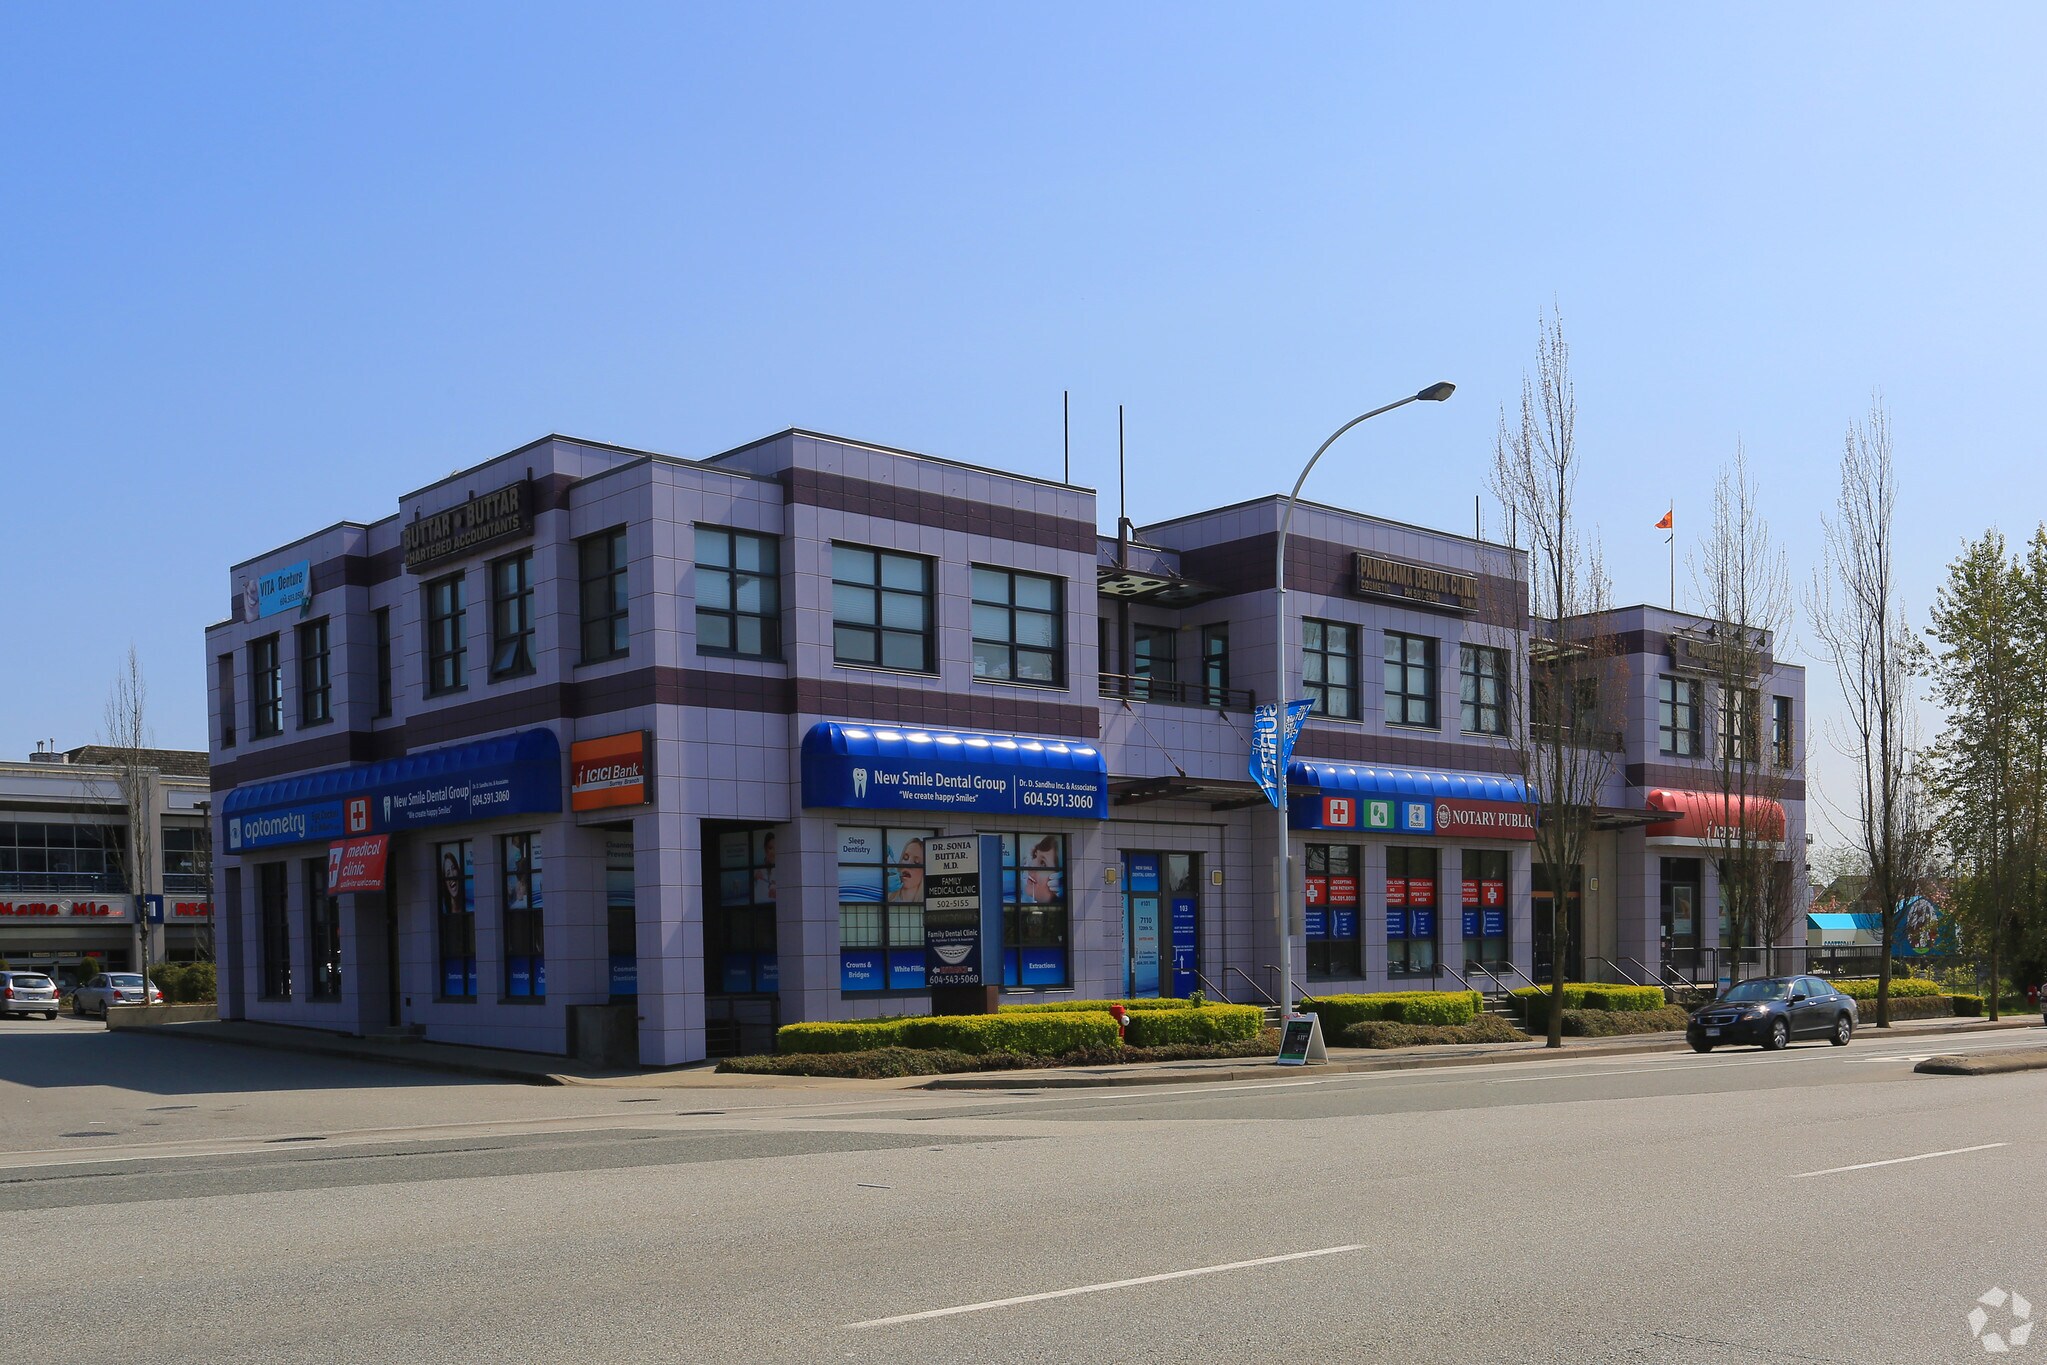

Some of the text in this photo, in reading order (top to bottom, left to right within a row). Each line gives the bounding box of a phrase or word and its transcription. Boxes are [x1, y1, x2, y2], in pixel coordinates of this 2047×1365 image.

[404, 487, 519, 550] BUTTAR BUTTAR
[404, 514, 520, 565] CHARTERED ACCOUNTANTS
[260, 571, 303, 597] VITA Denture
[1360, 557, 1479, 599] PANORAMA DENTAL CLINIC
[1360, 580, 1391, 593] COSMETIC
[586, 762, 639, 783] ICICI Bank
[874, 770, 1006, 793] New Smile Dental Group
[1019, 779, 1097, 792] Dr. D. Sandhu Inc. & Associates
[393, 785, 470, 809] New Smile Dental Group
[472, 789, 510, 806] 604.591.3060
[914, 792, 934, 801] create
[934, 792, 955, 803] happy
[1023, 791, 1093, 809] 604.591.3060
[1452, 809, 1496, 827] NOTARY
[244, 812, 306, 845] optometry
[848, 836, 865, 846] Sleep
[932, 841, 972, 851] DR. SONIA
[346, 839, 382, 858] medical
[842, 845, 871, 855] Dentistry
[342, 860, 366, 877] clinic
[941, 877, 962, 886] FAMILY
[928, 885, 977, 895] MEDICAL CLINIC
[72, 900, 109, 916] Mia
[936, 899, 969, 908] 502-5155
[1179, 904, 1188, 912] 103
[1139, 916, 1152, 924] 7110
[927, 928, 978, 939] Family Dental Clinic
[845, 961, 866, 969] Crowns
[893, 965, 910, 973] White
[848, 970, 870, 980] Bridges
